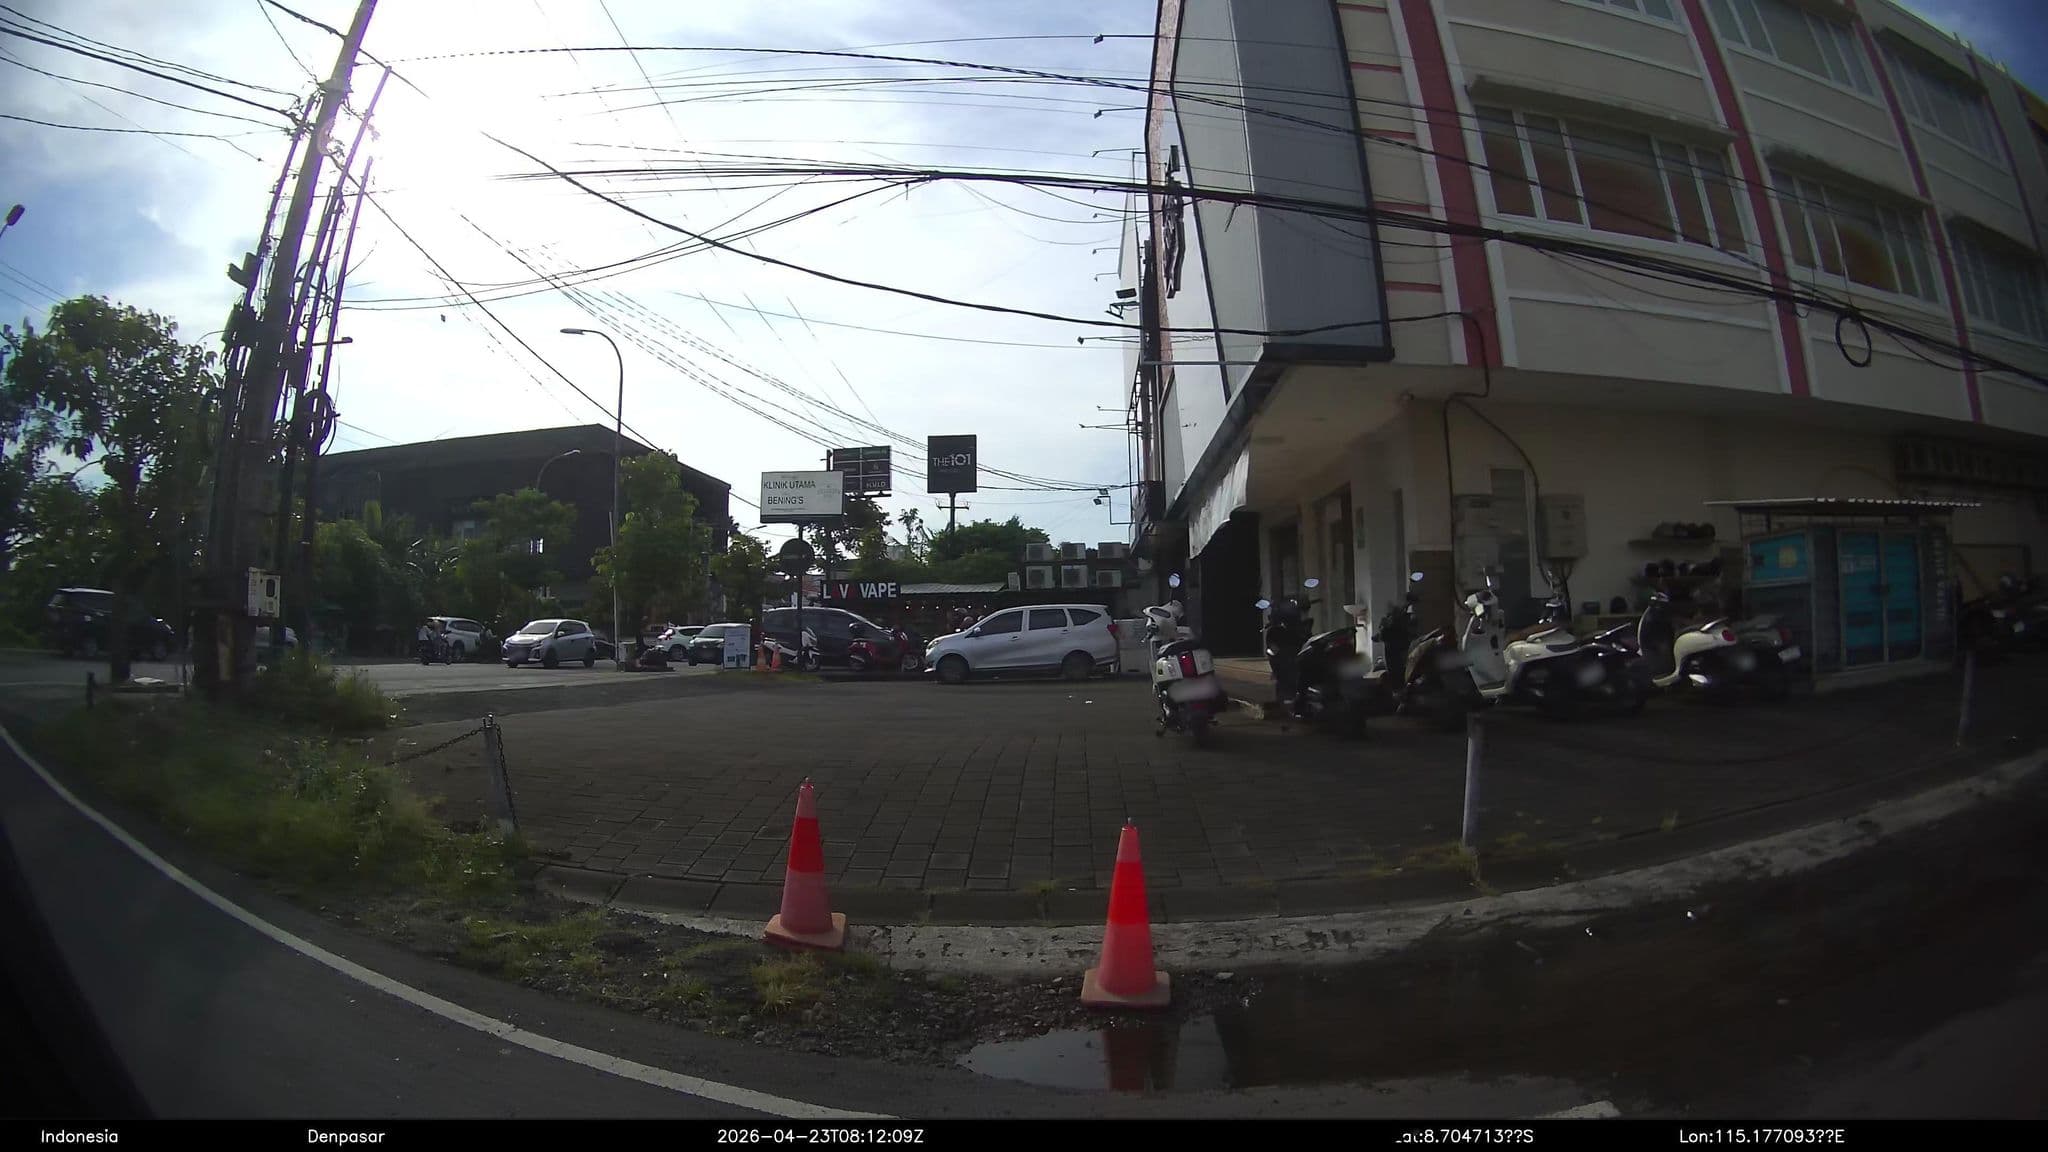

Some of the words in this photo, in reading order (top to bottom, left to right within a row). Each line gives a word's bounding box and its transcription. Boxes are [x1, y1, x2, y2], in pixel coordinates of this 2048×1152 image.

[932, 456, 949, 467] THE
[763, 480, 788, 490] KLINIK
[789, 480, 816, 490] UTAMA
[859, 582, 897, 599] VAPE
